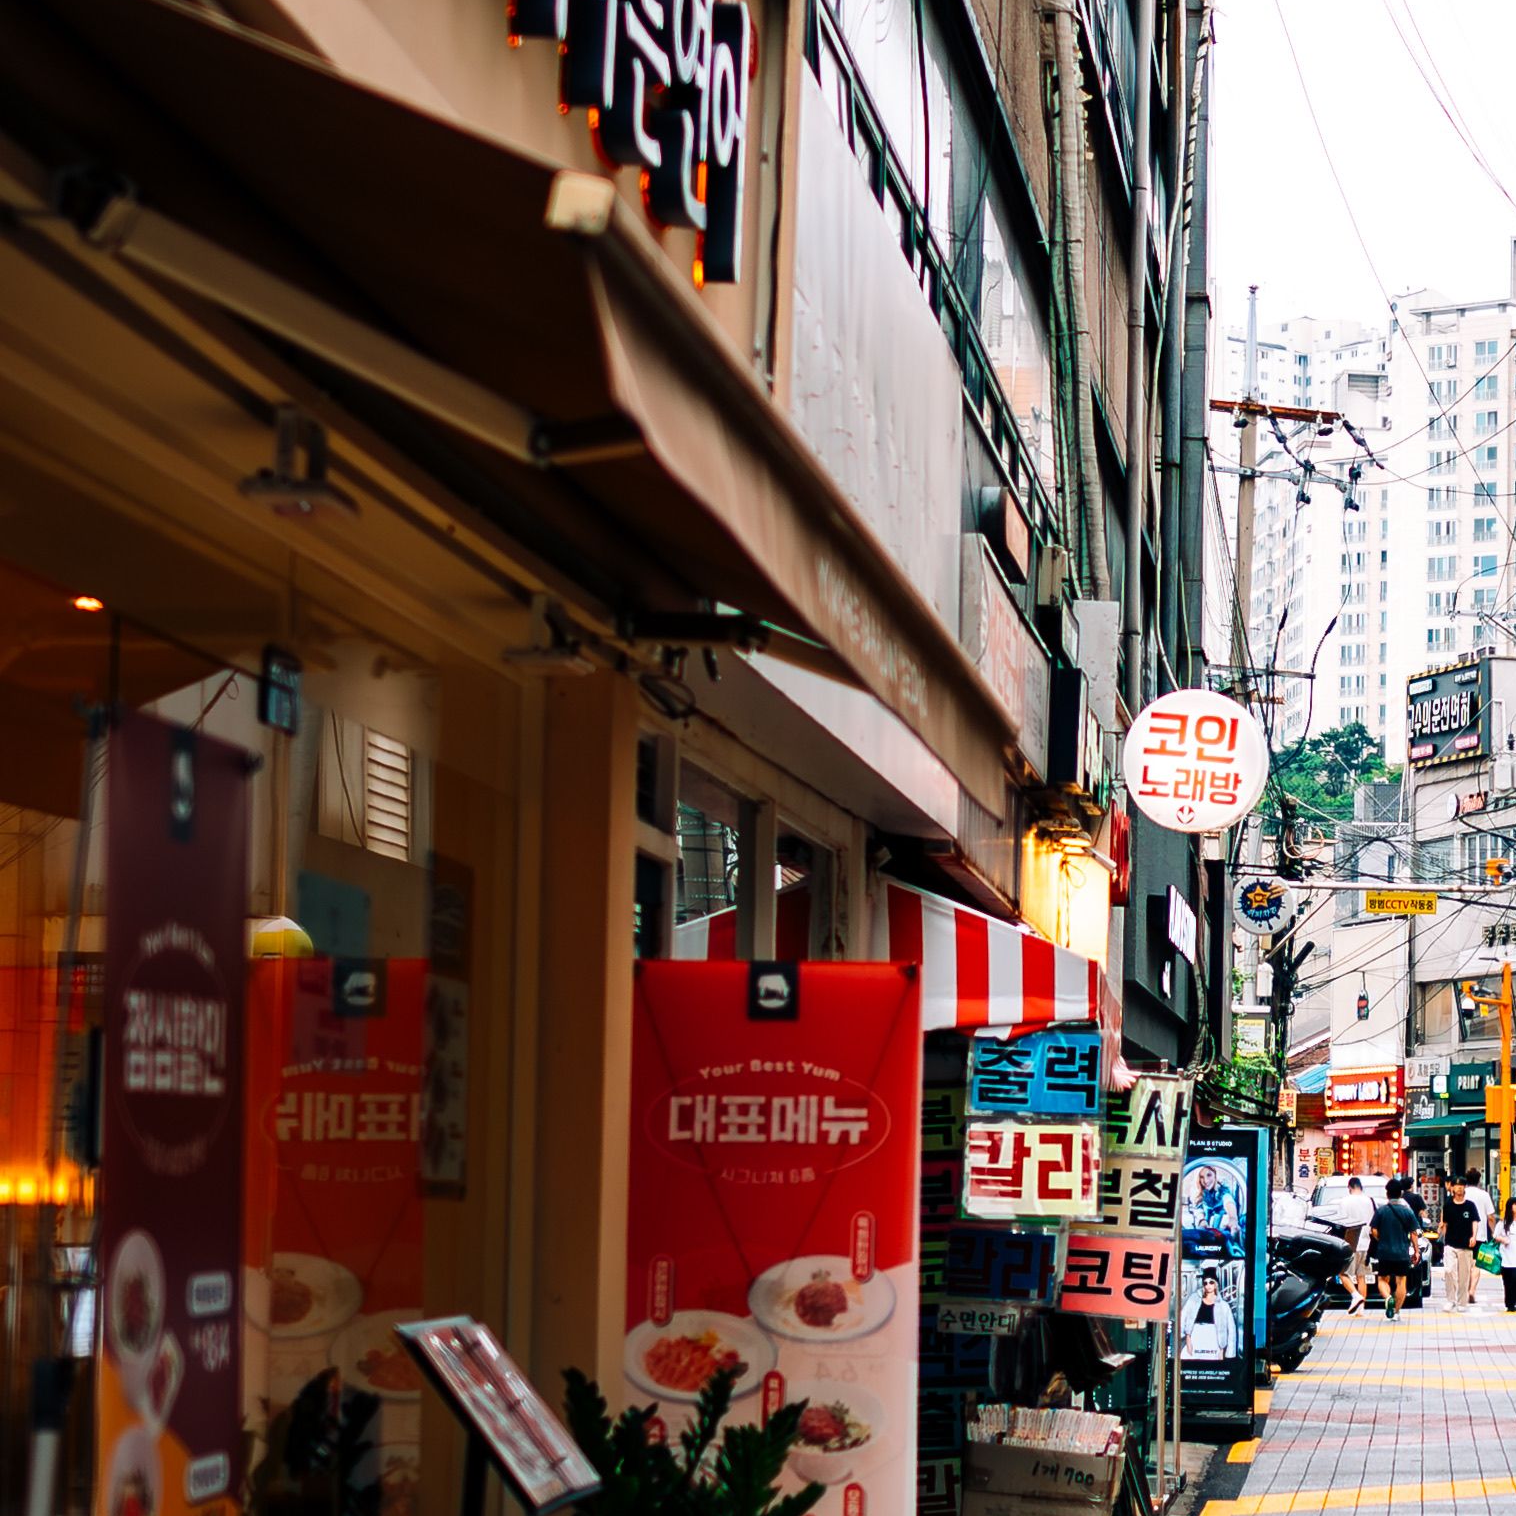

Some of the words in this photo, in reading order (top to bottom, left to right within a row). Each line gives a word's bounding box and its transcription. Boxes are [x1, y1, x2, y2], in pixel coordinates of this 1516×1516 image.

[1143, 711, 1239, 764] 코인
[1139, 765, 1242, 805] 노래방
[699, 1062, 744, 1080] Your
[750, 1059, 795, 1073] Best
[801, 1061, 842, 1082] Yum
[974, 1039, 1101, 1109] 출력
[668, 1095, 869, 1145] 대표메뉴
[968, 1131, 1101, 1200] 칼라
[1061, 1249, 1170, 1305] 코팅
[940, 1309, 1017, 1334] 수면안대
